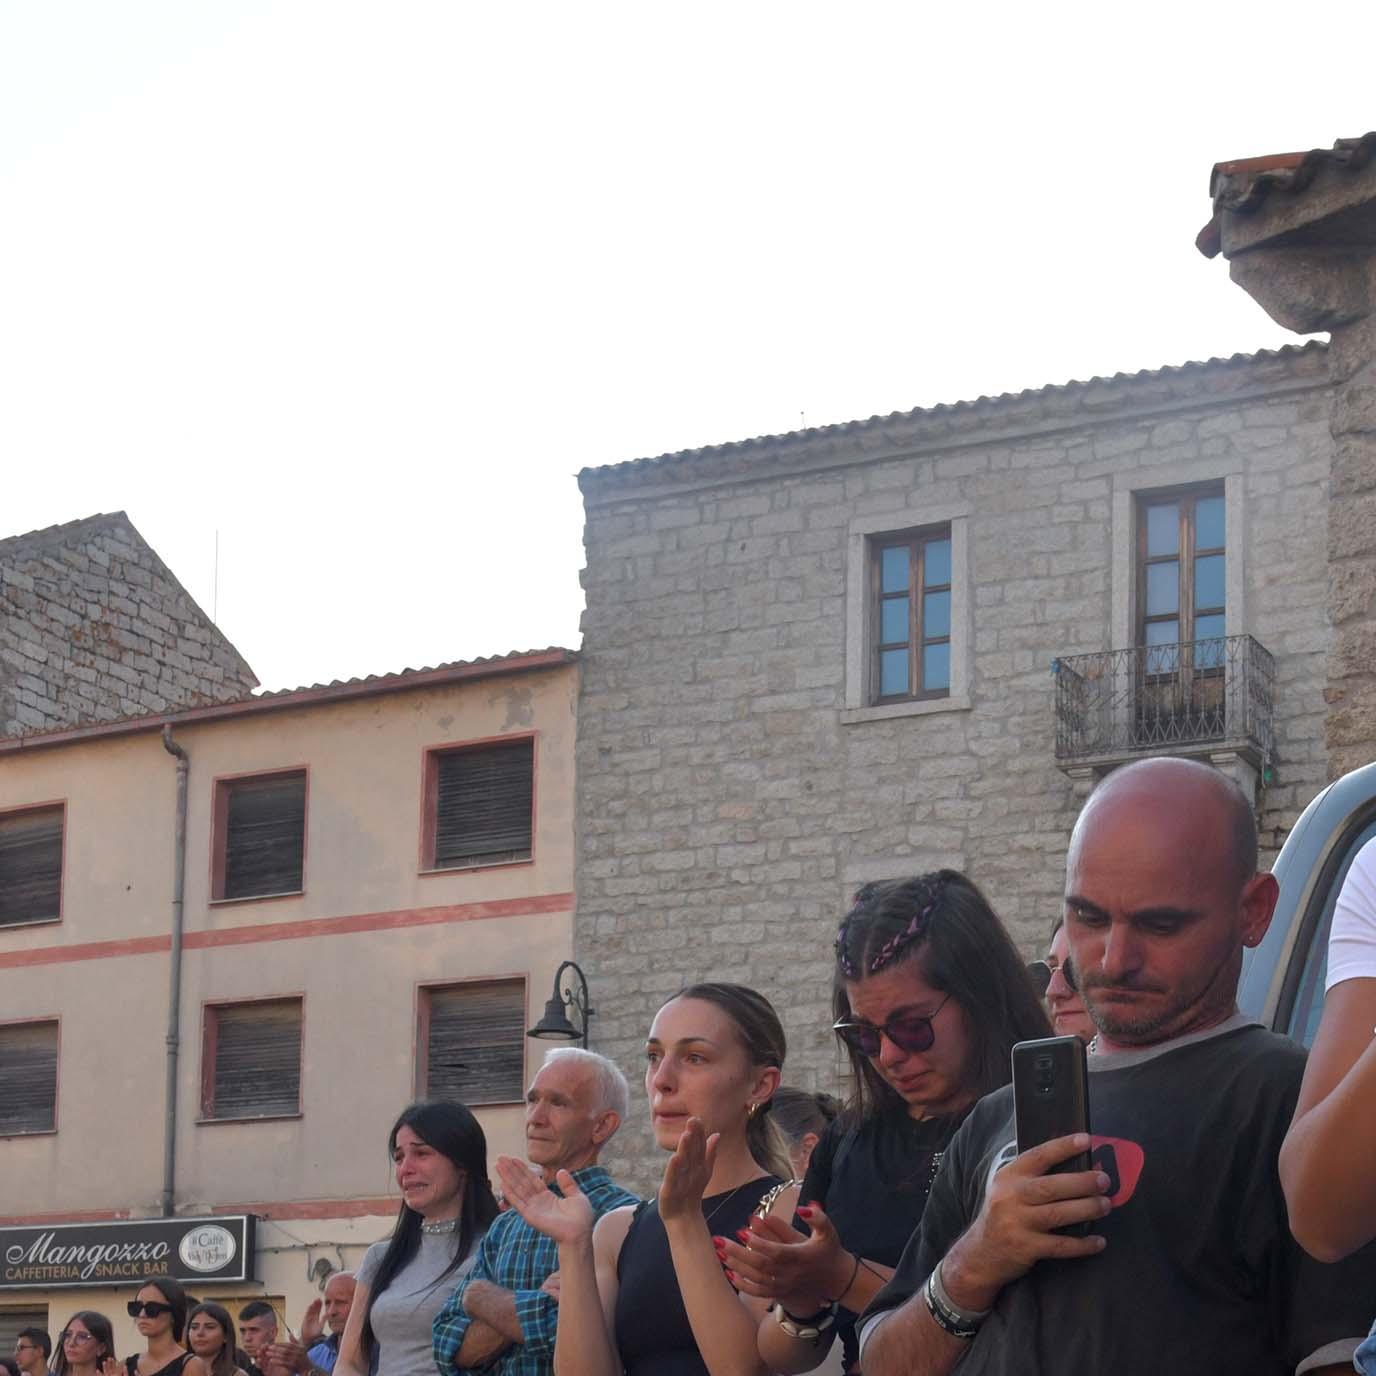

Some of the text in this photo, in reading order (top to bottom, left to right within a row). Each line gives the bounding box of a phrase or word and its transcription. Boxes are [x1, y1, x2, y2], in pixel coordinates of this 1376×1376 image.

[5, 1260, 169, 1281] CAFFETTERIA SNACK BAR
[6, 1232, 170, 1280] Mangozzo
